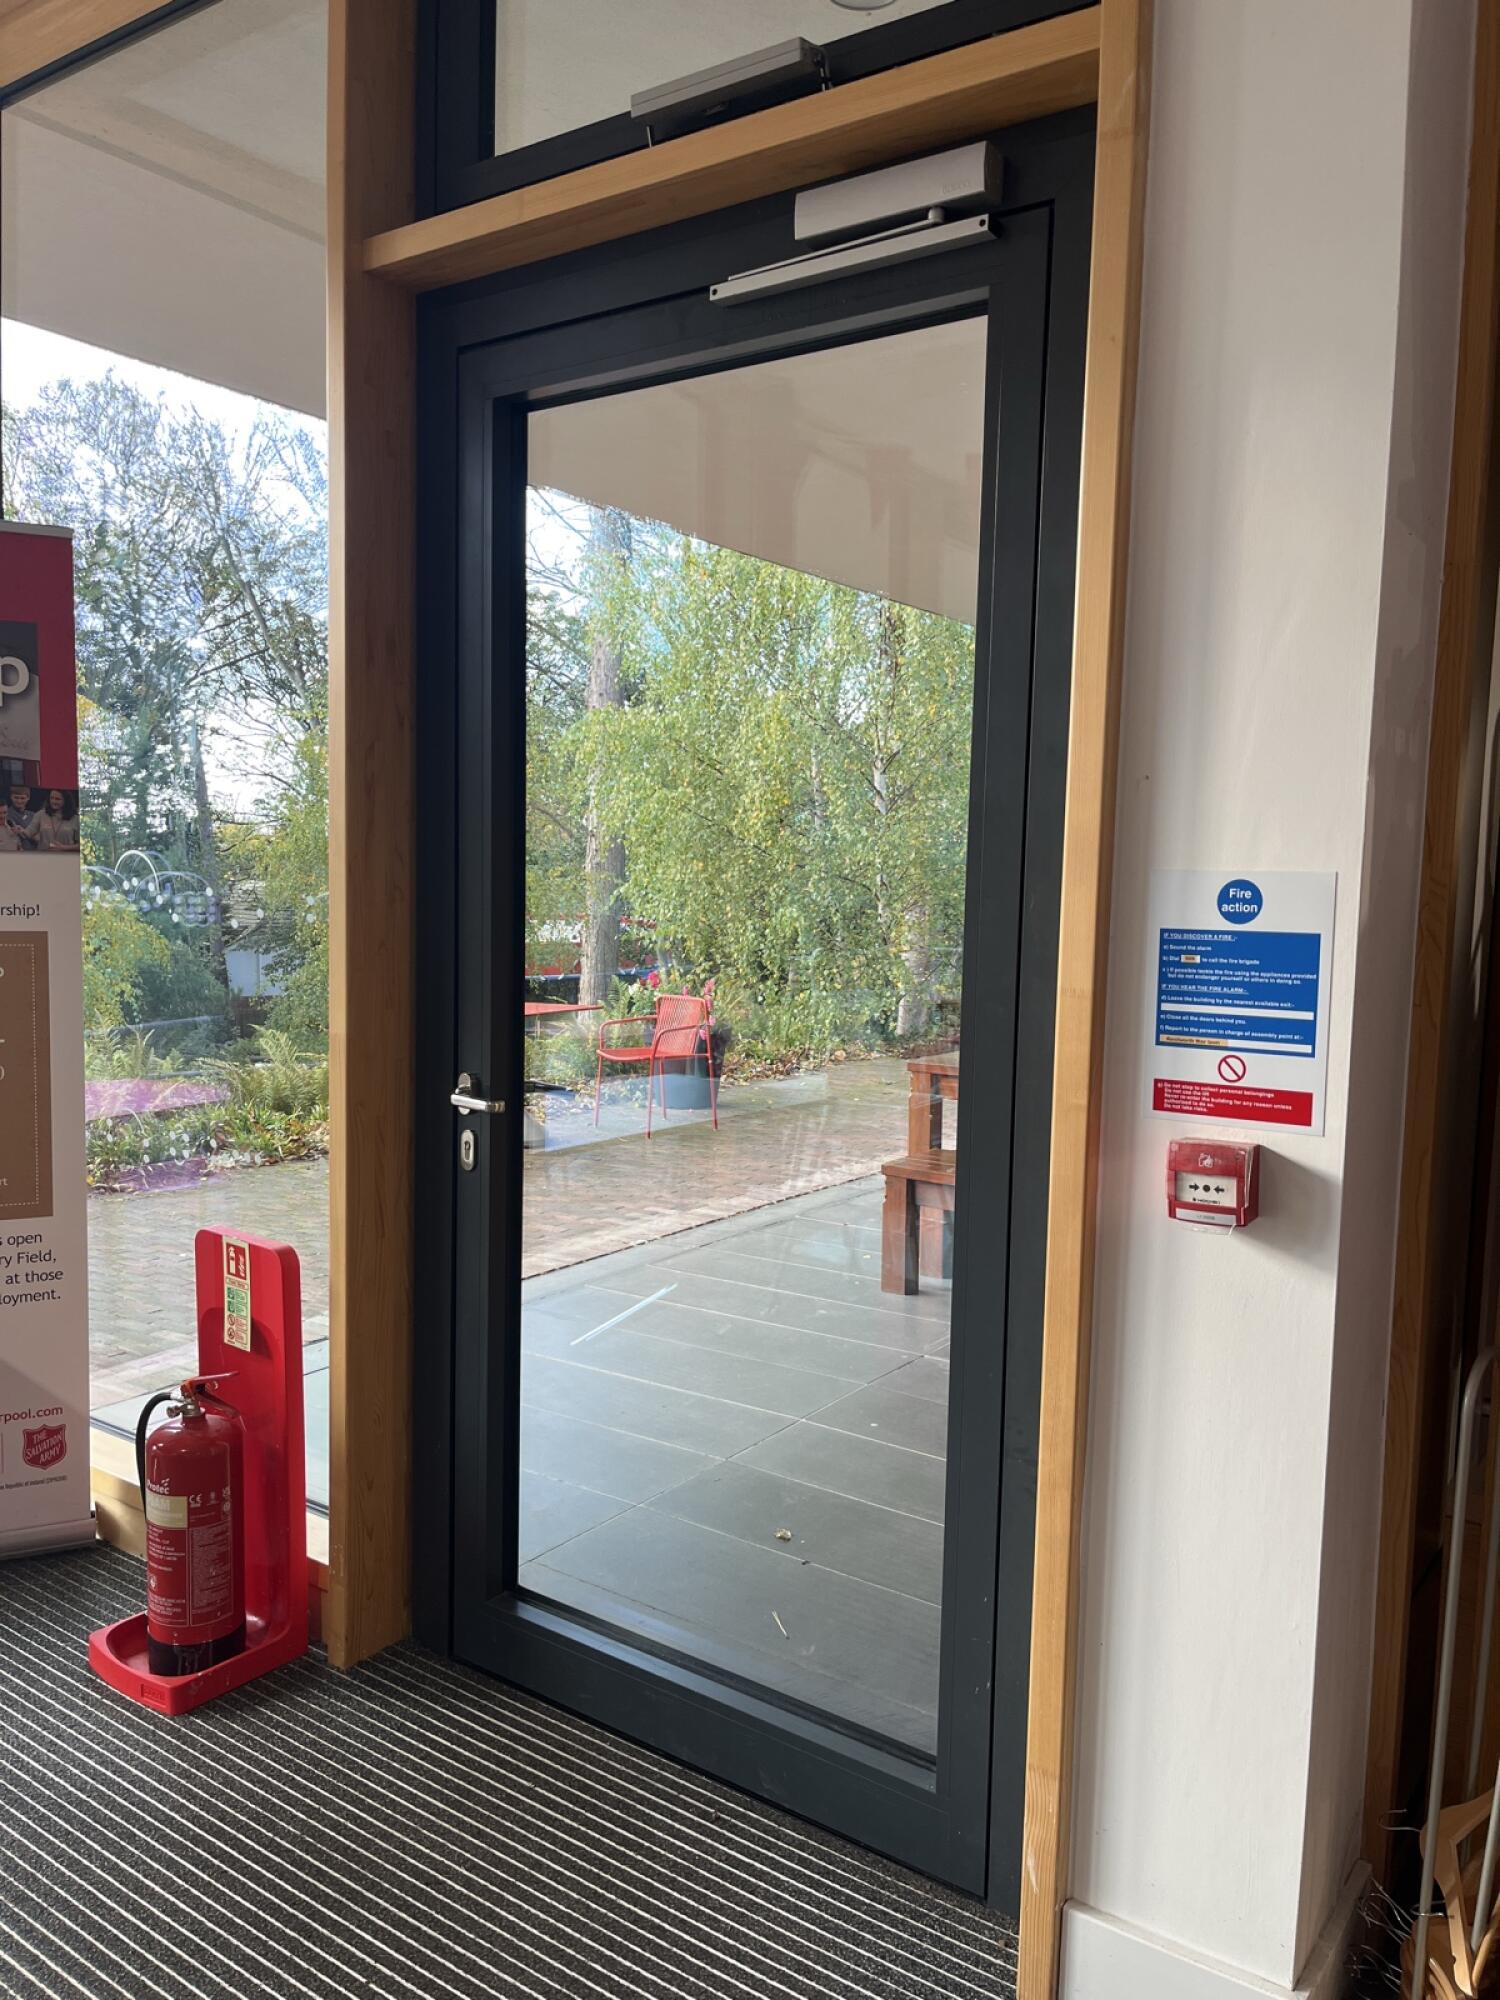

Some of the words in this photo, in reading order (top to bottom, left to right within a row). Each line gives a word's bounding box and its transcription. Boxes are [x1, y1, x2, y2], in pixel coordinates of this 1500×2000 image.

[1229, 888, 1252, 899] Fire
[0, 904, 40, 919] rship!
[1221, 902, 1259, 913] action
[7, 1233, 42, 1248] open
[17, 1249, 56, 1264] Field,
[5, 1273, 20, 1284] at
[25, 1270, 64, 1283] those
